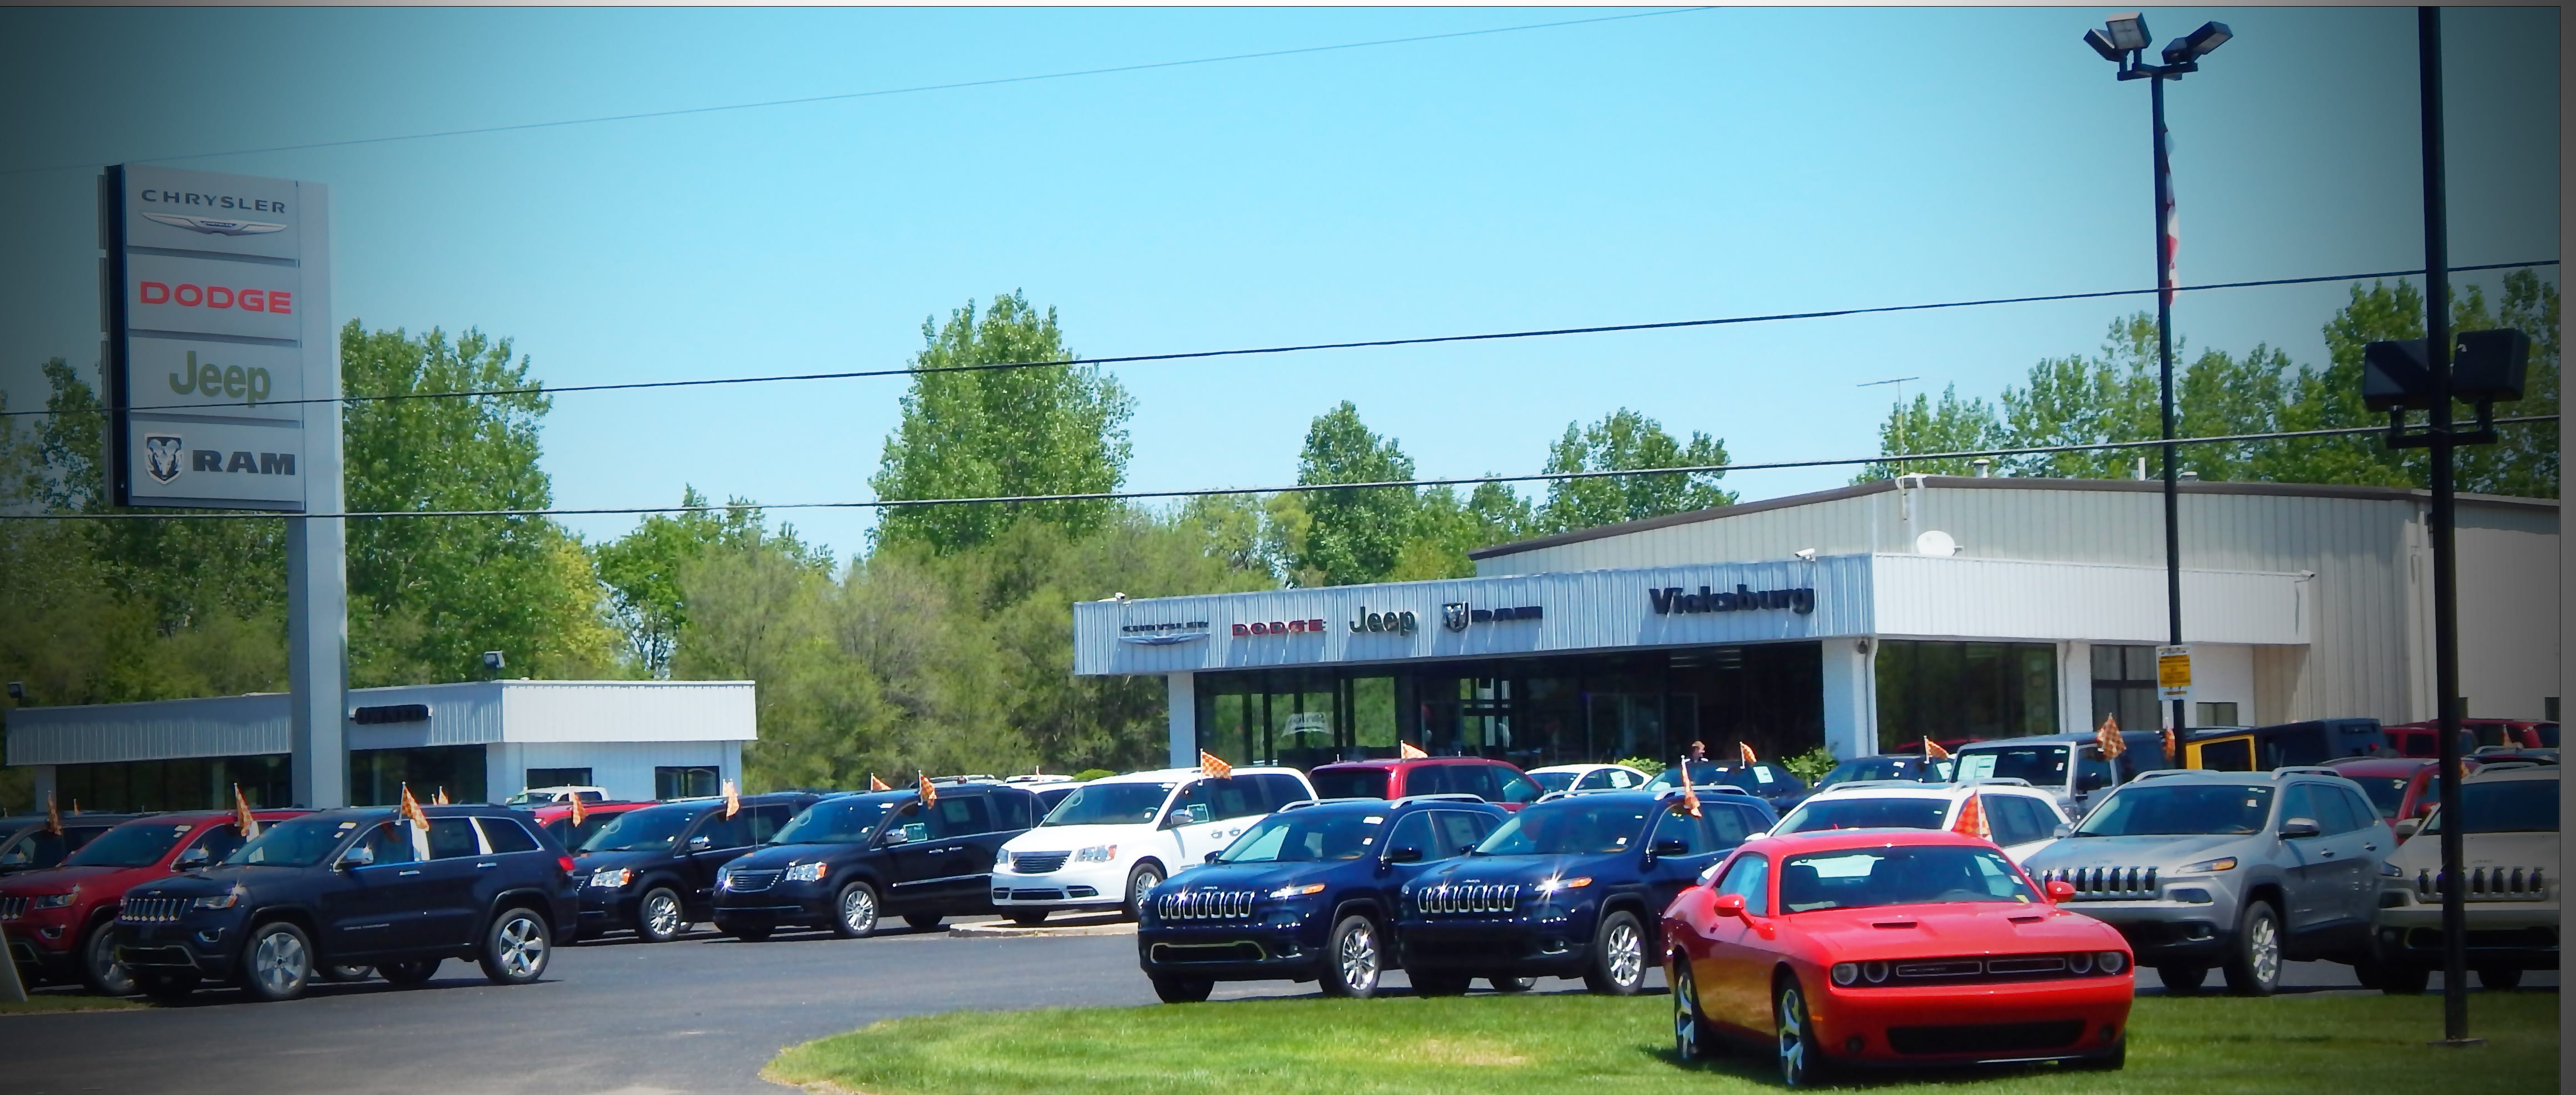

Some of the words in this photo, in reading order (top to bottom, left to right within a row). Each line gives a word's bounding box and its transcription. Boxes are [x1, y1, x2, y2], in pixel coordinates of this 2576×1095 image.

[141, 189, 285, 214] CHRYSLER
[140, 280, 292, 314] DODGE
[169, 351, 271, 408] Jeep
[192, 449, 296, 476] RAM
[1648, 584, 1815, 615] Vicksburg
[1232, 619, 1323, 637] DODGE
[1349, 606, 1416, 637] Jeep
